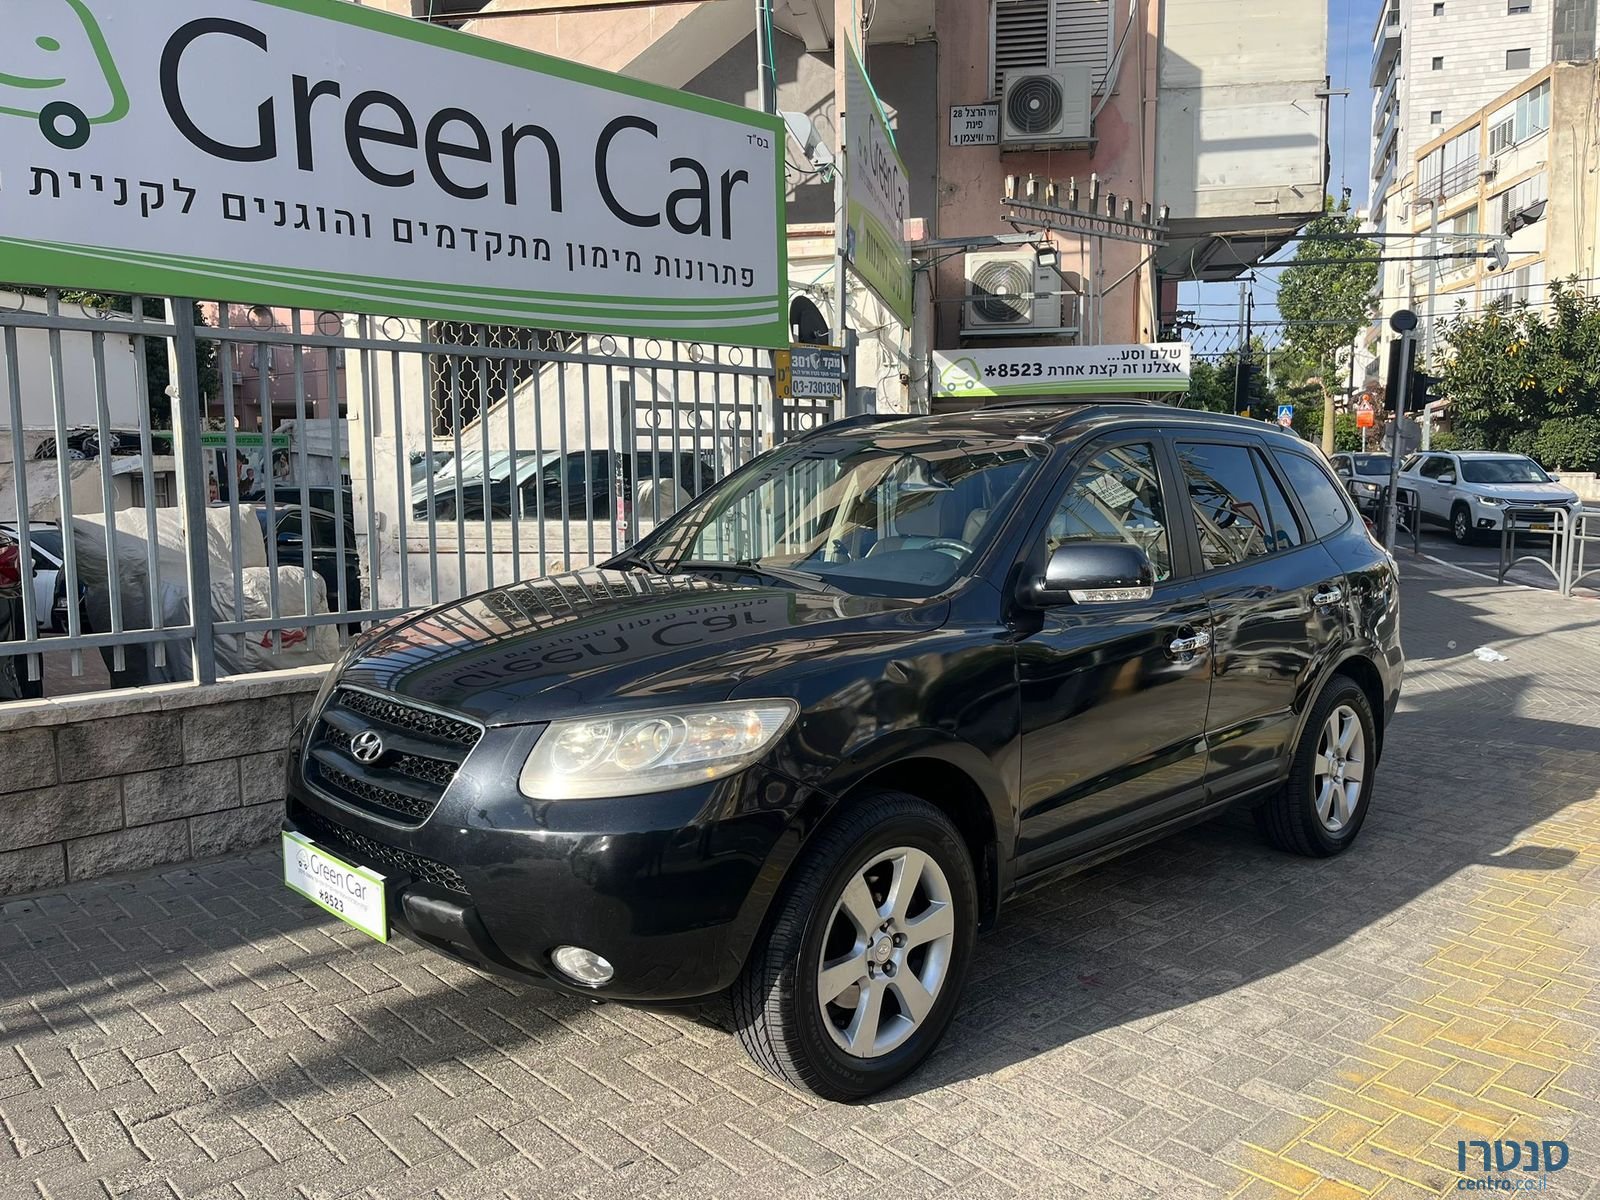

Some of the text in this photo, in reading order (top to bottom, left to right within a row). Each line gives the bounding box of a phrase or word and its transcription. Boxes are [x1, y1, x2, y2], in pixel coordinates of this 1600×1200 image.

[953, 109, 963, 118] 28
[965, 107, 987, 118] הרצל
[160, 18, 562, 212] Green
[595, 116, 748, 240] Car
[965, 120, 984, 130] פינת
[746, 134, 769, 149] בס"ד
[954, 134, 958, 143] 1
[29, 167, 754, 288] פתרונות מימון מתקדמים והוגנים לקניית
[1150, 347, 1181, 360] שלם
[792, 355, 811, 368] 301
[1142, 361, 1181, 374] אצלנו
[1047, 365, 1085, 376] אחרת
[1088, 364, 1118, 378] קצת
[1122, 363, 1138, 374] זה
[311, 854, 344, 889] Green
[346, 873, 367, 901] Car
